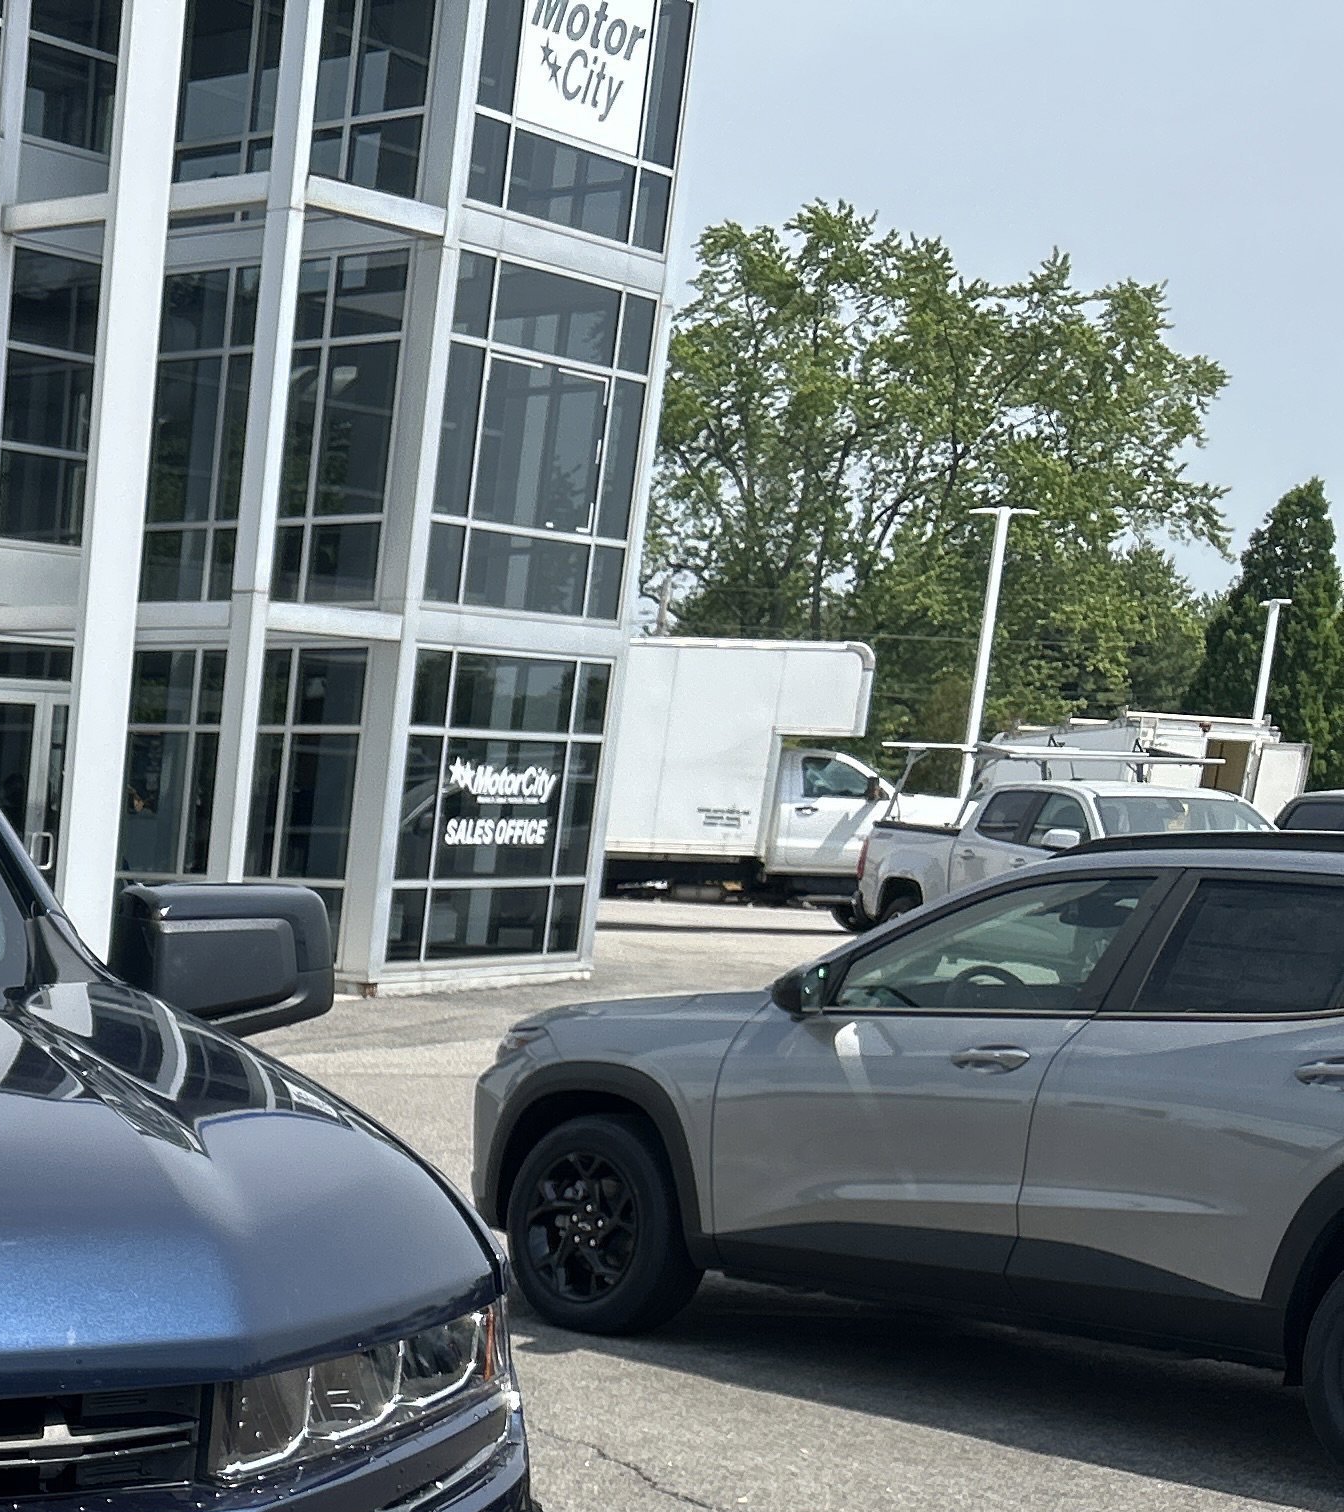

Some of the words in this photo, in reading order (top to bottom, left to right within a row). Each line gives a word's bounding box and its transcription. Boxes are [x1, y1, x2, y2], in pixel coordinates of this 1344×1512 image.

[531, 0, 647, 61] Motor
[562, 48, 624, 122] City
[472, 764, 558, 804] MotorCity
[444, 818, 495, 845] SALES
[495, 818, 549, 845] OFFICE
